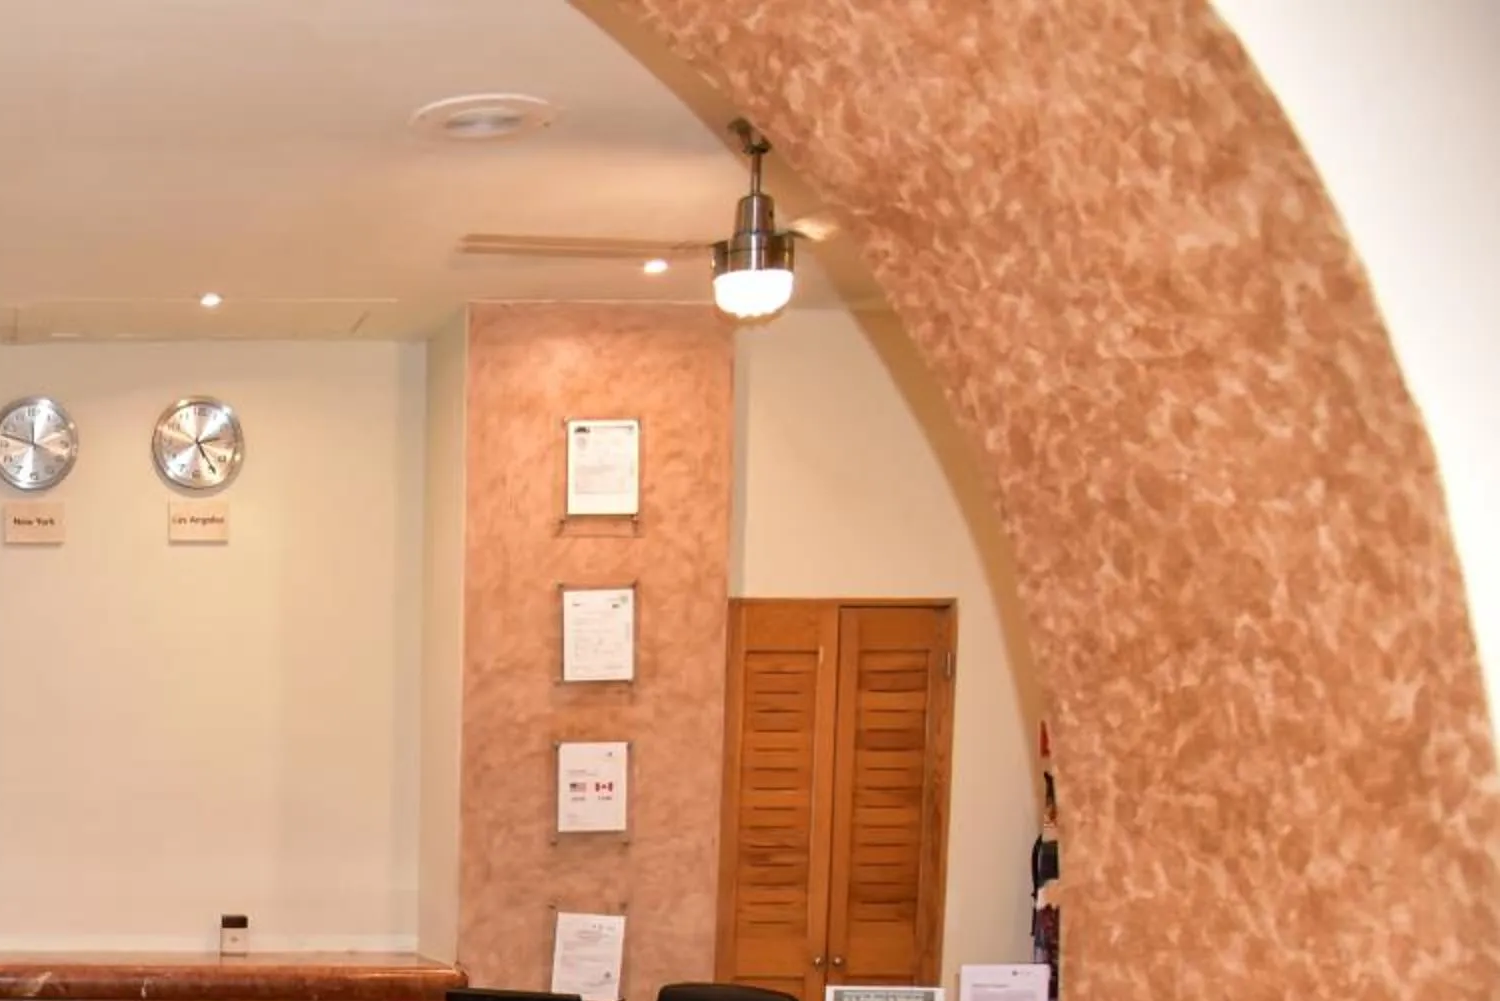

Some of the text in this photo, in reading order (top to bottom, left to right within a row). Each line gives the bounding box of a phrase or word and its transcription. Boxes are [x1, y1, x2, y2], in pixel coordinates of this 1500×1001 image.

[13, 515, 56, 525] New York
[171, 515, 188, 525] Los
